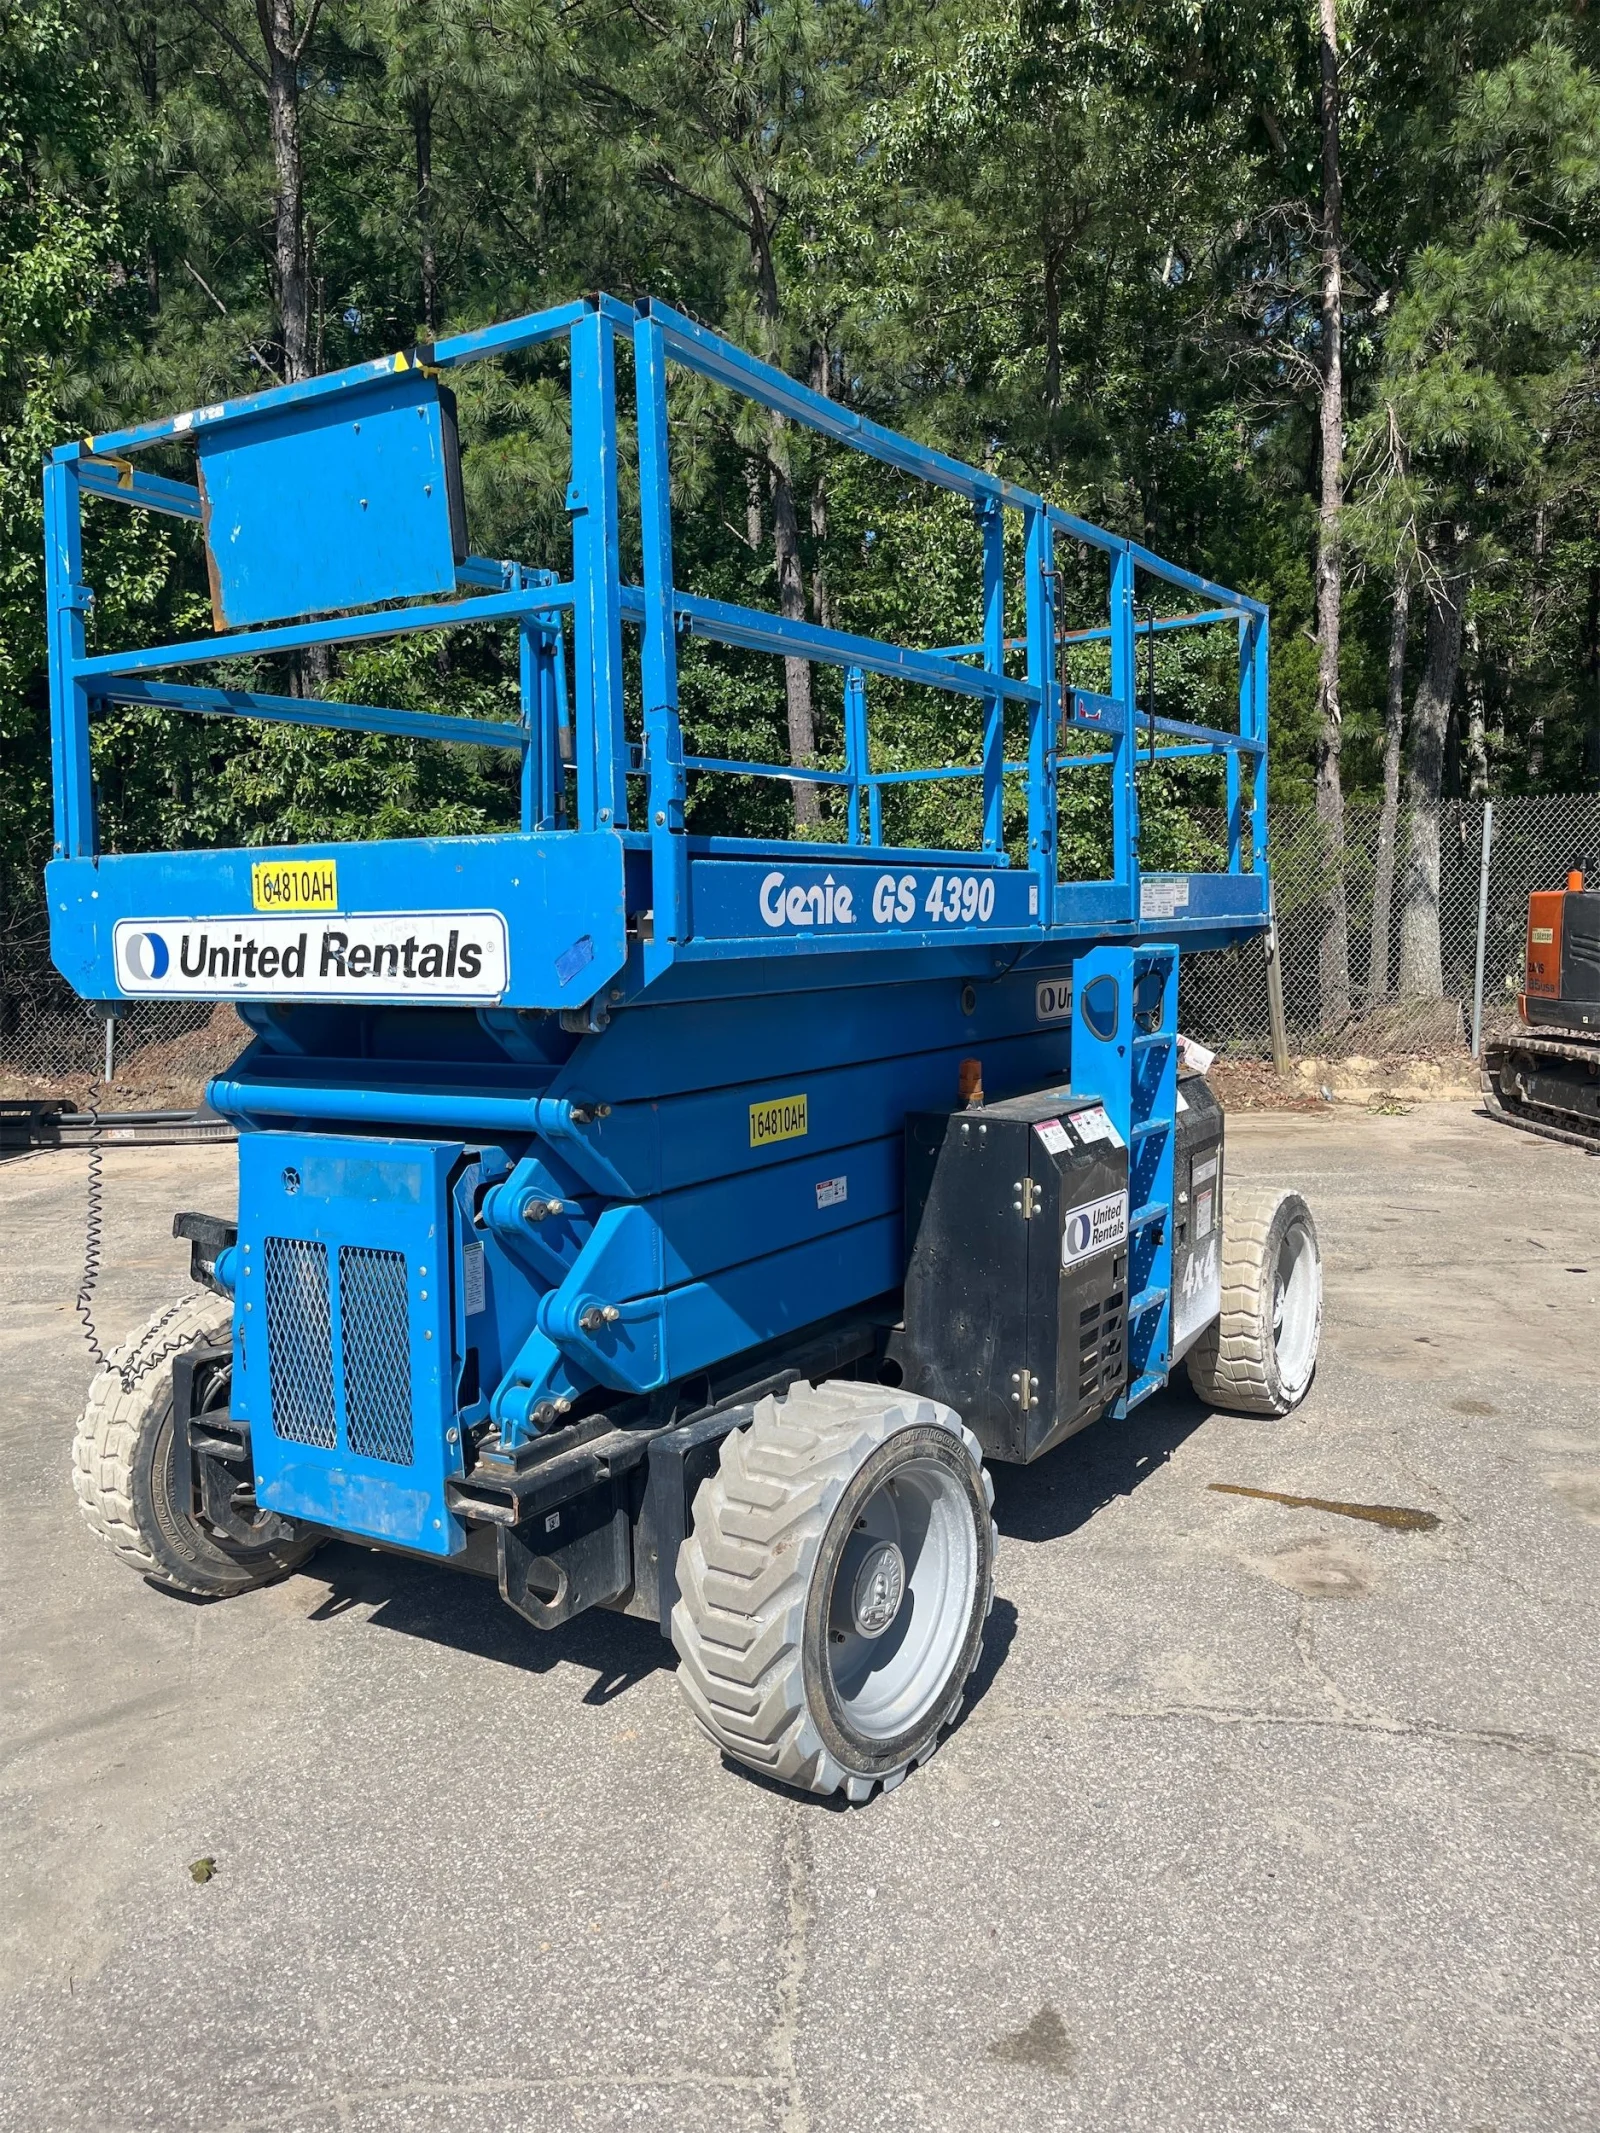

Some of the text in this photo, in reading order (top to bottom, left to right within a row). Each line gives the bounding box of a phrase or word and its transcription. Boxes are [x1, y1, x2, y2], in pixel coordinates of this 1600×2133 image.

[254, 871, 334, 902] 164810AH
[759, 871, 854, 928] Genie
[872, 874, 917, 924] GS
[925, 875, 996, 923] 4390
[180, 929, 483, 979] United Rentals
[751, 1103, 806, 1140] 164810AH
[1092, 1200, 1123, 1227] United
[1092, 1218, 1124, 1246] Rentals
